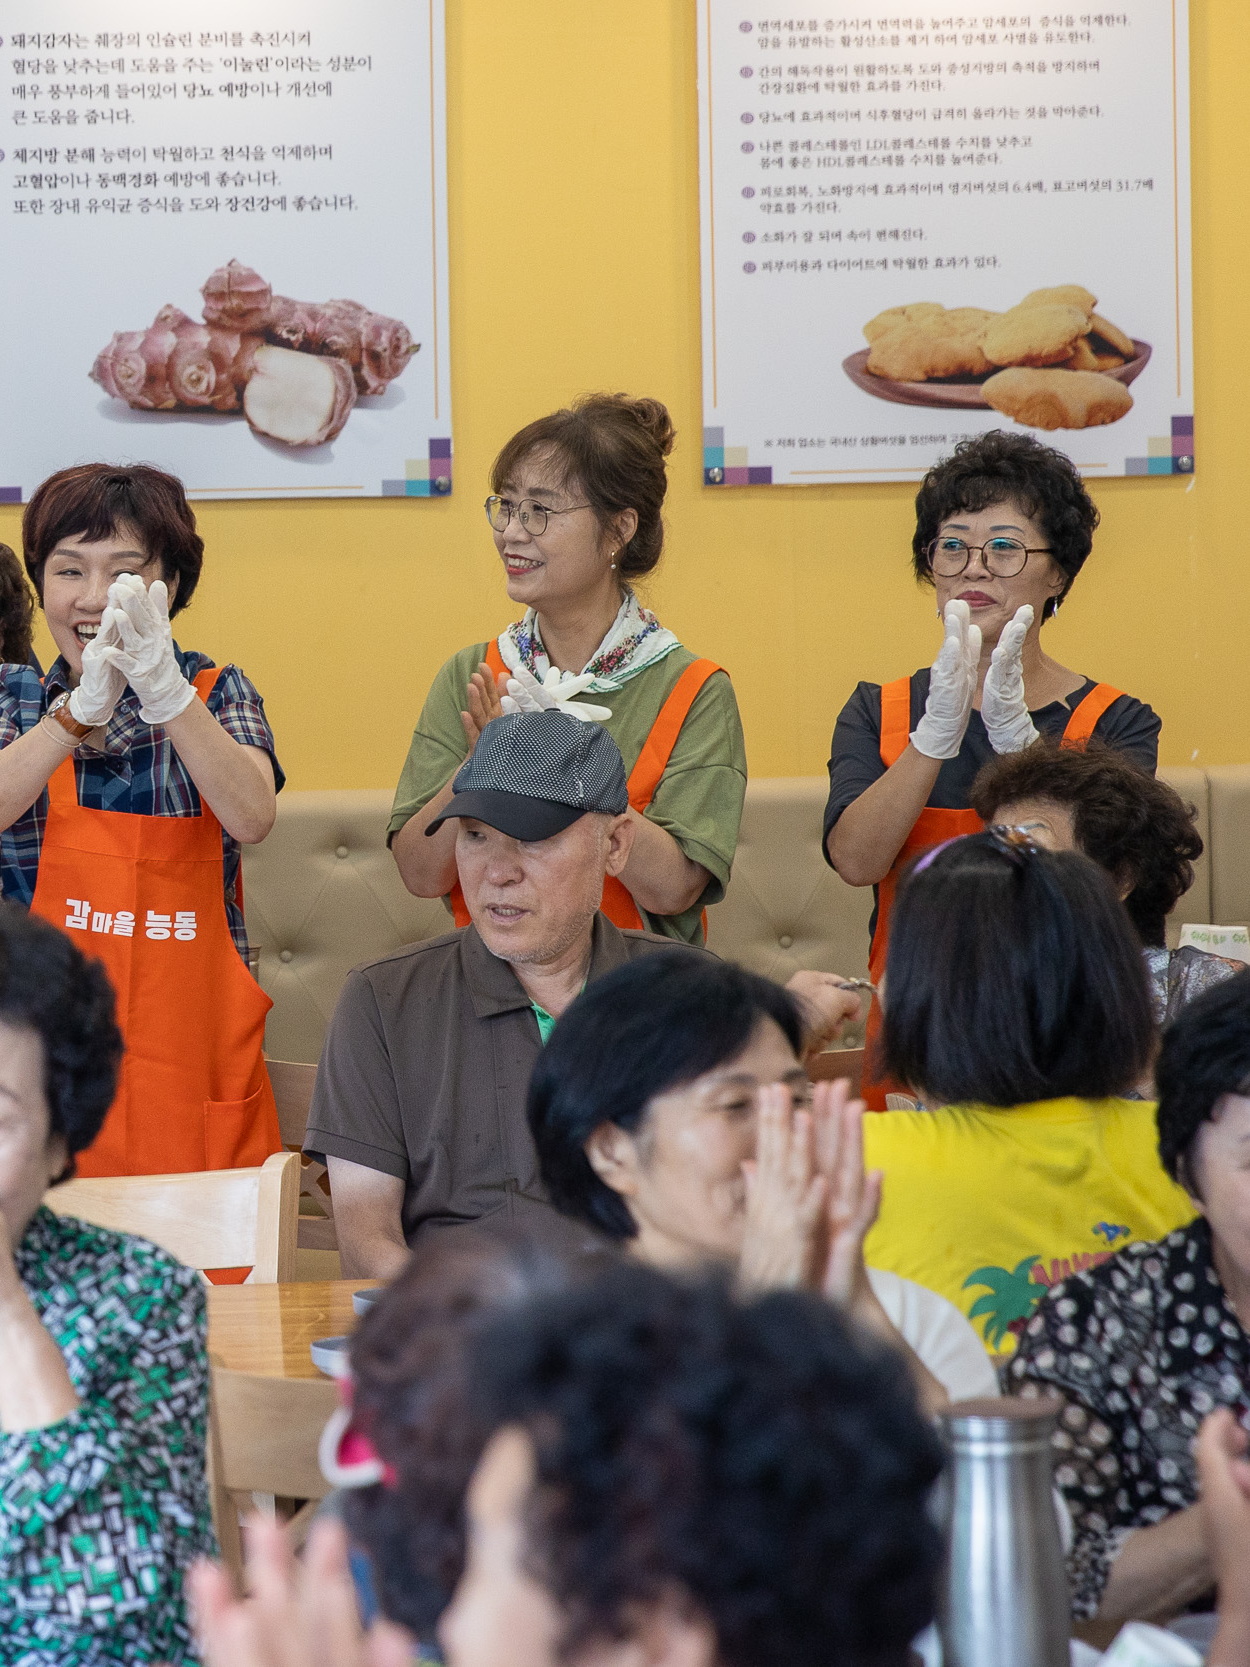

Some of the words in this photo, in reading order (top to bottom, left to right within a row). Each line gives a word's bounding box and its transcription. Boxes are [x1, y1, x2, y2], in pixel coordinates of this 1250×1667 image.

[11, 32, 89, 50] 돼지감자는
[146, 32, 192, 47] 인슐린
[198, 31, 244, 47] 분비를
[12, 59, 58, 75] 혈당을
[64, 58, 124, 74] 낮추는데
[131, 58, 177, 73] 도움을
[183, 57, 213, 73] 주는
[327, 55, 371, 72] 성분이
[12, 84, 42, 100] 매우
[48, 83, 109, 100] 풍부하게
[116, 83, 176, 99] 들어있어
[183, 83, 213, 99] 당뇨
[219, 81, 281, 98] 예방이나
[288, 81, 332, 97] 개선에
[11, 110, 28, 125] 큰
[32, 109, 80, 125] 도움을
[84, 109, 134, 125] 줍니다.
[13, 148, 60, 164] 체지방
[65, 148, 95, 164] 분해
[101, 147, 146, 162] 능력이
[153, 146, 214, 162] 탁월하고
[221, 145, 266, 162] 천식을
[272, 145, 332, 160] 억제하며
[13, 172, 92, 189] 고혈압이나
[96, 172, 160, 189] 동맥경화
[164, 171, 210, 187] 예방에
[215, 170, 281, 187] 좋습니다.
[13, 199, 45, 214] 또한
[49, 198, 80, 215] 장내
[85, 198, 133, 214] 유익균
[137, 197, 185, 213] 증식을
[189, 196, 221, 212] 도와
[225, 196, 287, 212] 장건강에
[292, 194, 358, 212] 좋습니다.
[65, 898, 136, 937] 감마을
[145, 910, 197, 941] 능동
